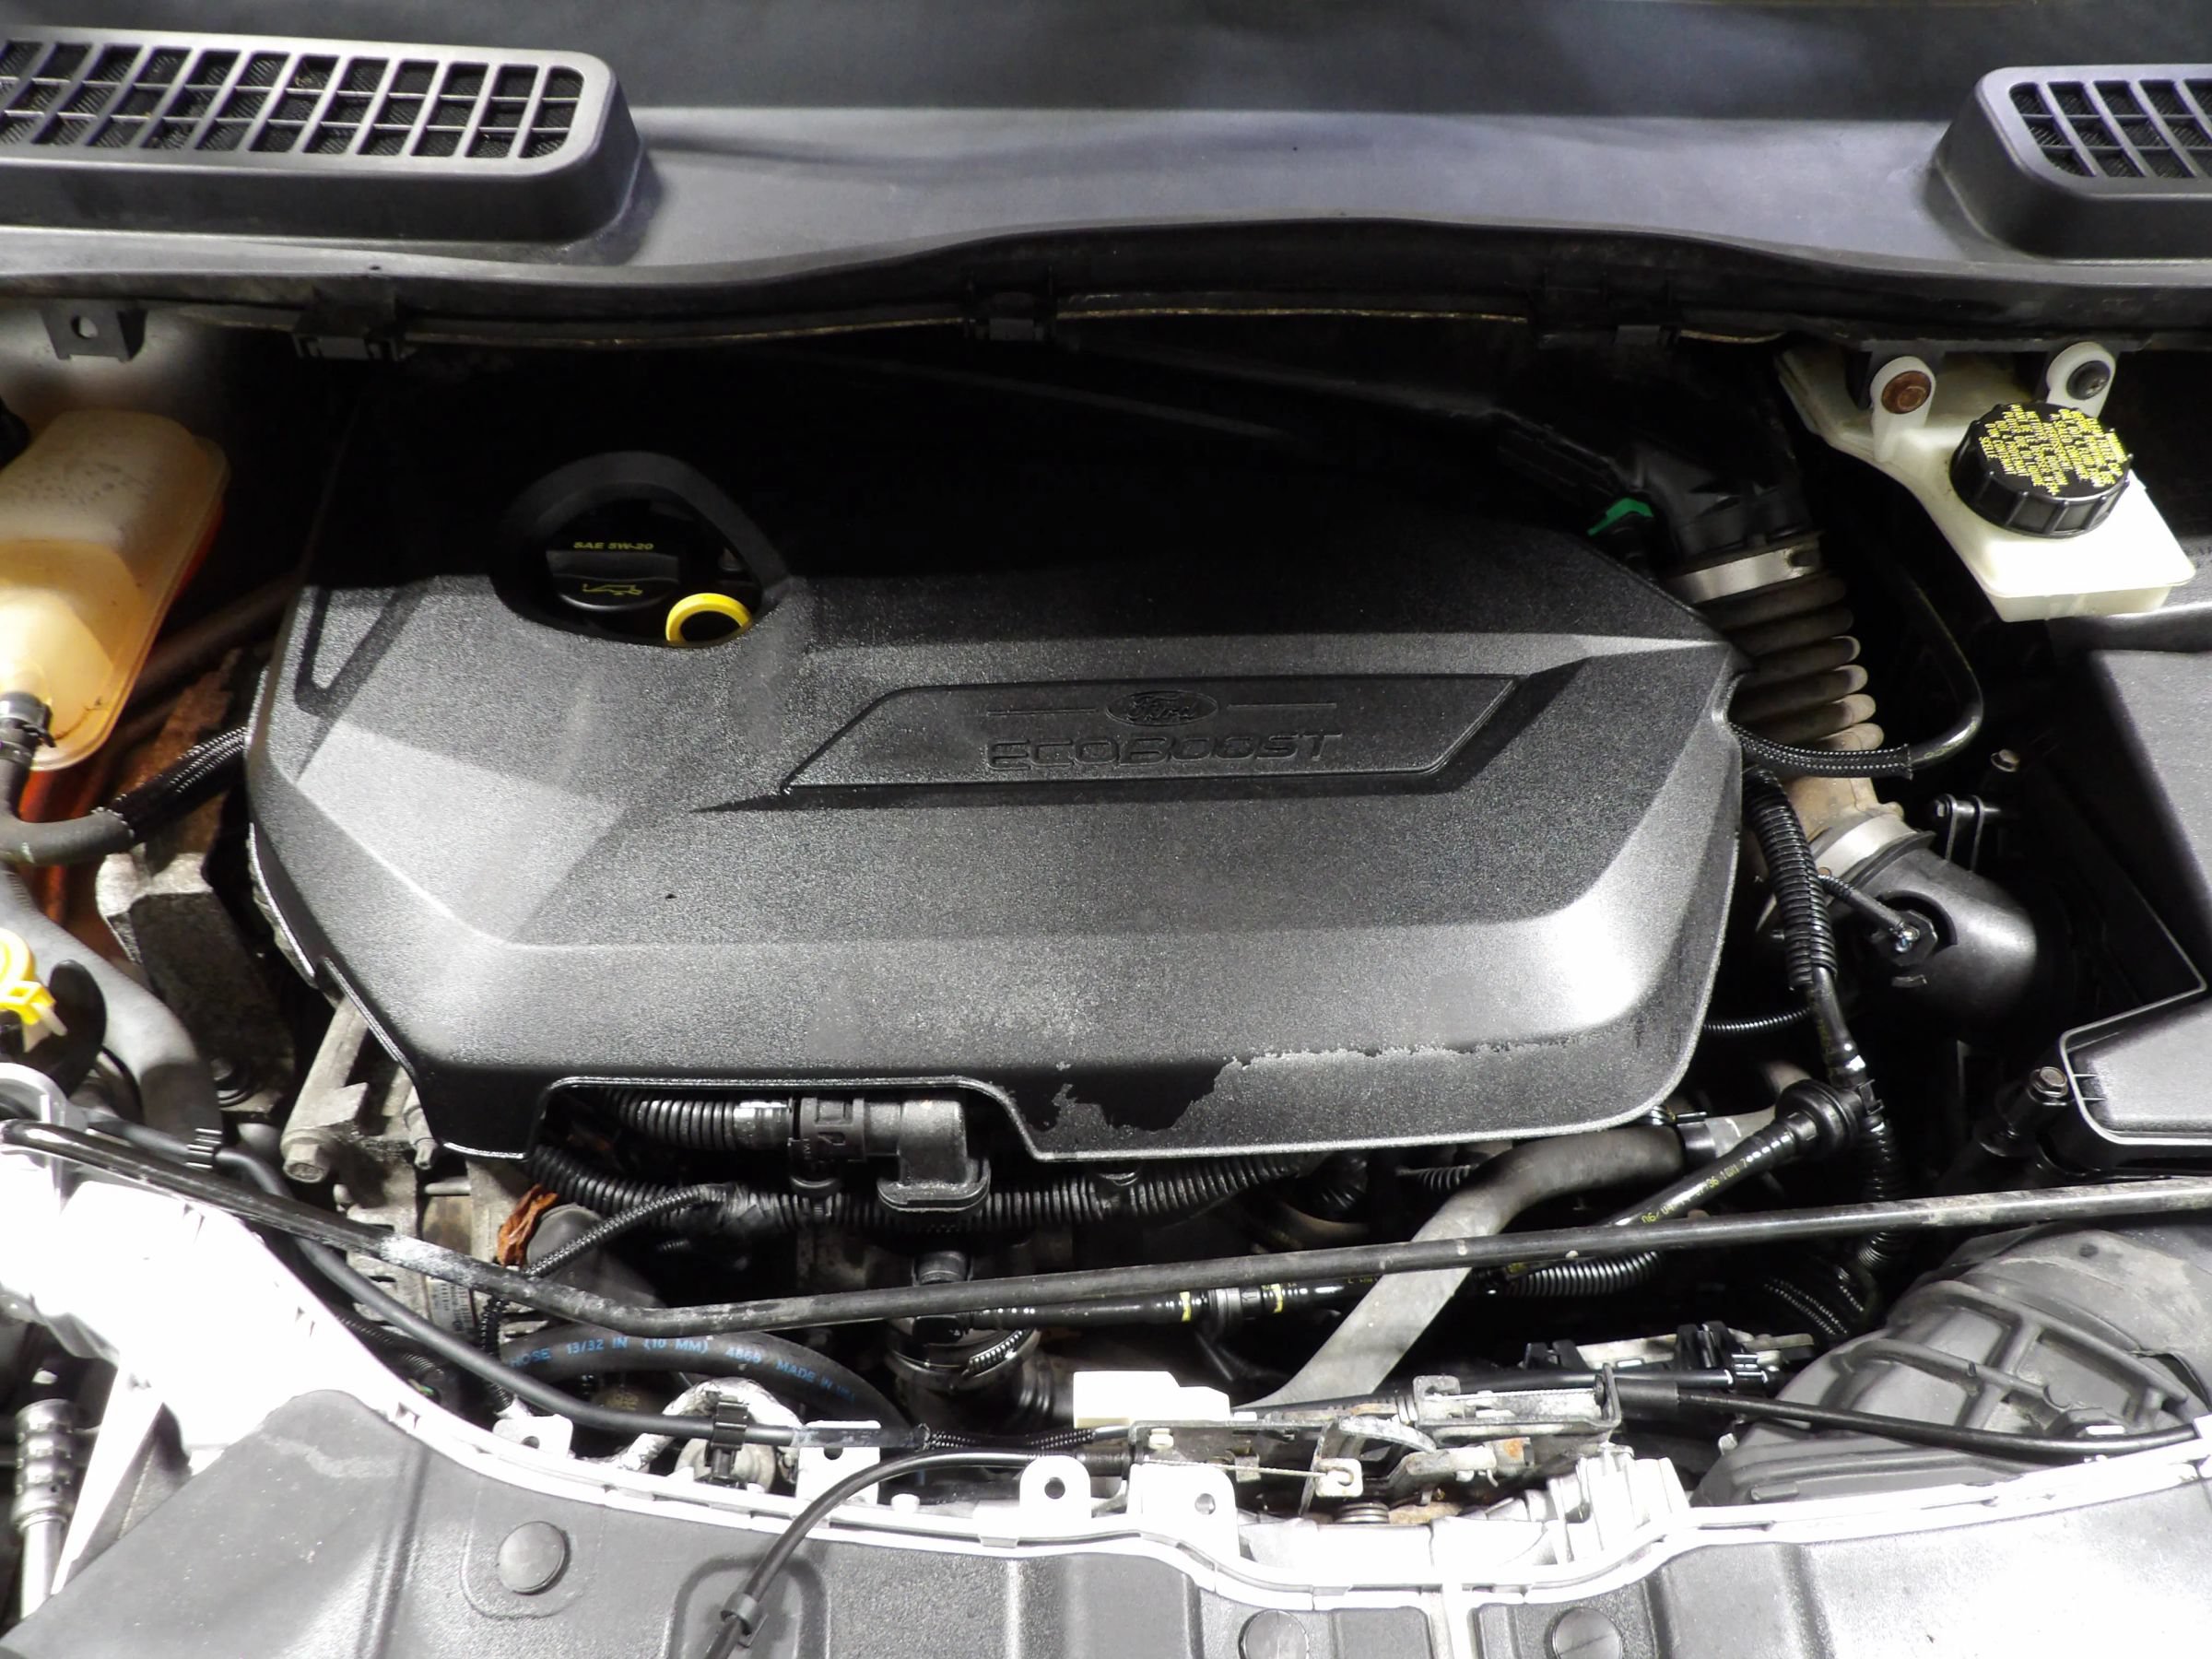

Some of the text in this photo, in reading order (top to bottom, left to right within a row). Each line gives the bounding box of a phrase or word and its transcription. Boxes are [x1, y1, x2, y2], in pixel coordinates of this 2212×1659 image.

[2052, 419, 2073, 442] SEALED
[1991, 439, 2018, 475] CONTENANT
[2012, 435, 2029, 447] QUE
[2022, 461, 2045, 487] LIQUIDE
[573, 541, 654, 550] SAE 5W-20
[1126, 694, 1196, 723] Ford
[985, 732, 1343, 772] ECOBOOST
[567, 1338, 605, 1355] 13/32
[611, 1335, 628, 1349] IN
[641, 1337, 667, 1350] (10
[675, 1337, 709, 1354] MM)
[776, 1359, 818, 1383] MADE
